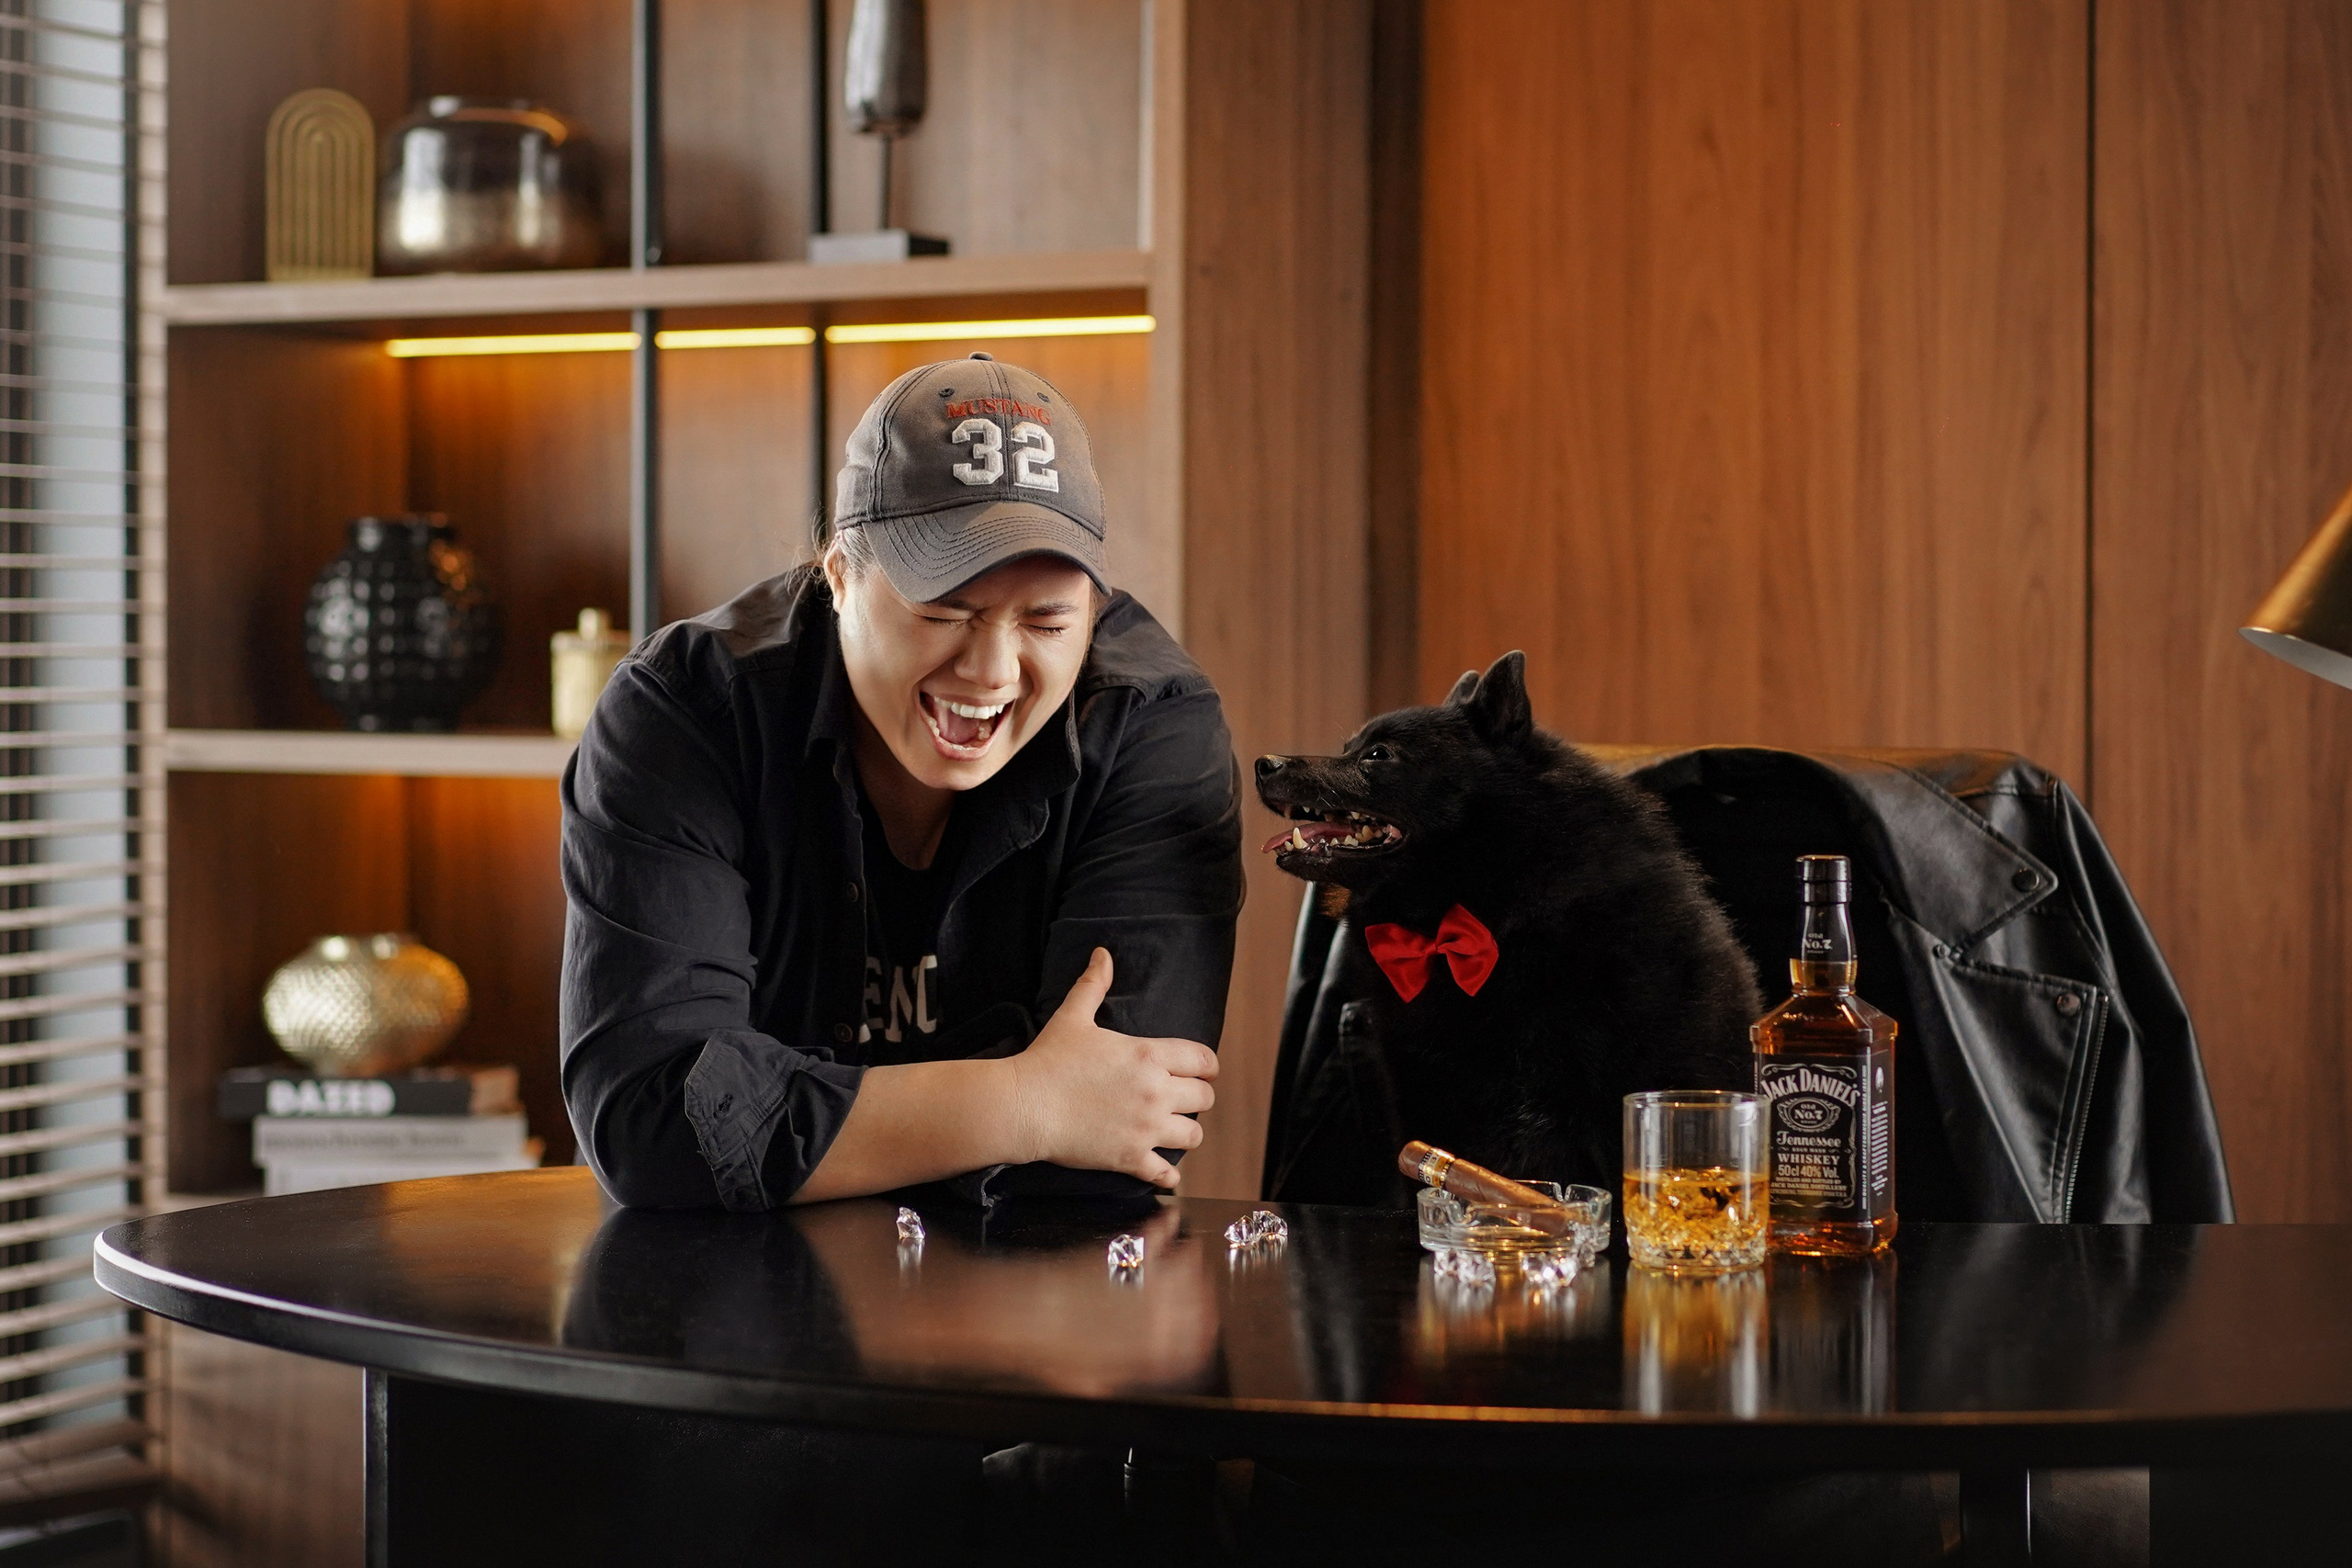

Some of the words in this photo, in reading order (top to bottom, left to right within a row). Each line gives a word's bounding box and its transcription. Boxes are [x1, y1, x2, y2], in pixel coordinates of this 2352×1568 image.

[946, 398, 1052, 426] MUSTANG
[952, 418, 1059, 493] 32
[1760, 1073, 1800, 1102] JACK
[1799, 1067, 1861, 1108] DANIEL'S
[1794, 1109, 1823, 1120] No.7
[1776, 1130, 1842, 1147] Tennessee
[1778, 1153, 1840, 1166] WHISKEY
[1778, 1164, 1800, 1177] 50cl
[1800, 1165, 1822, 1178] 40%
